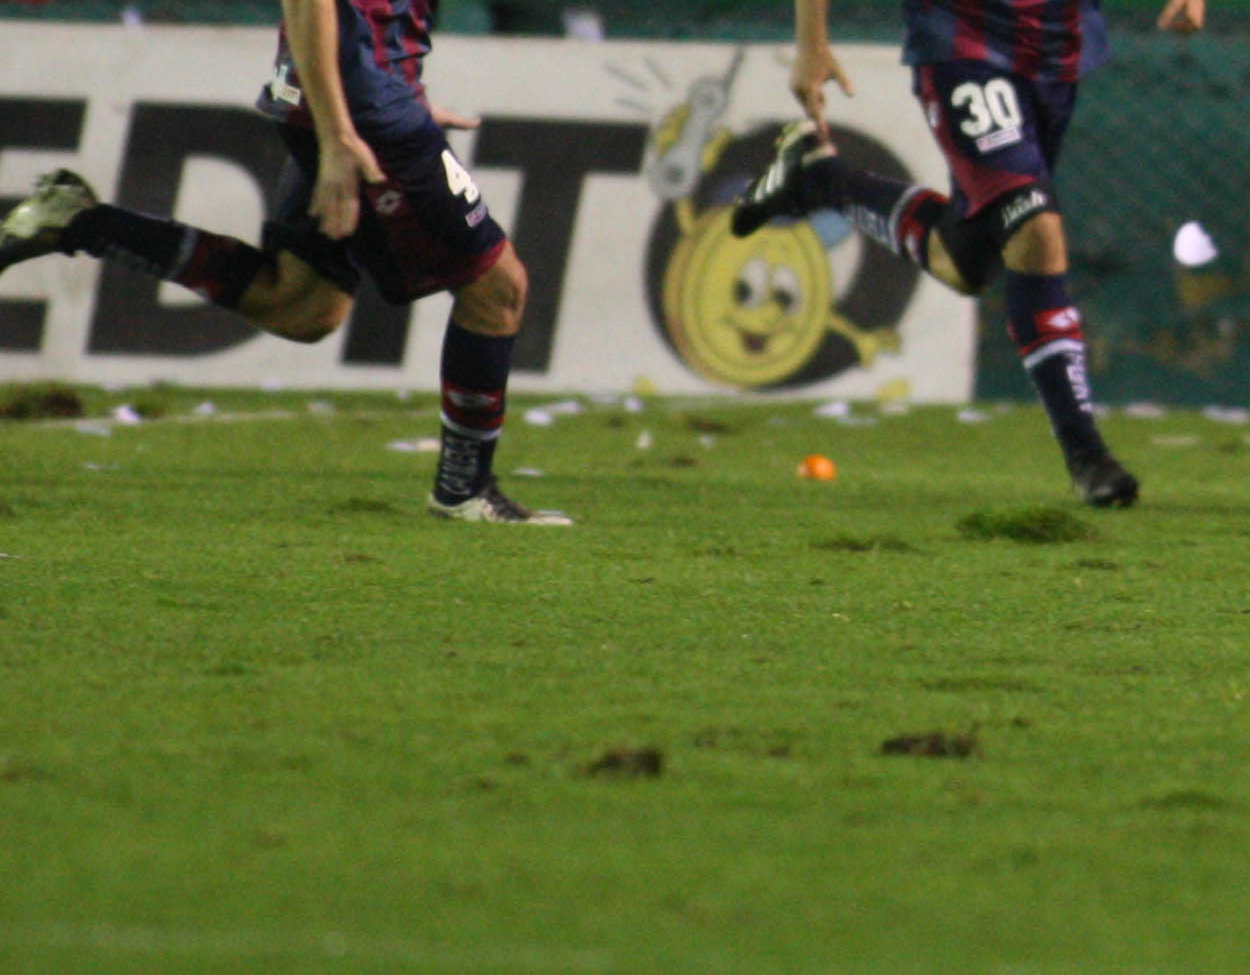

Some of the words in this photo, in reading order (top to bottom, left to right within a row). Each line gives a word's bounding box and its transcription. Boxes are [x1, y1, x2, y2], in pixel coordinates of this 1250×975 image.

[951, 78, 1022, 138] 30
[441, 149, 479, 204] 4
[0, 96, 925, 391] DTO
